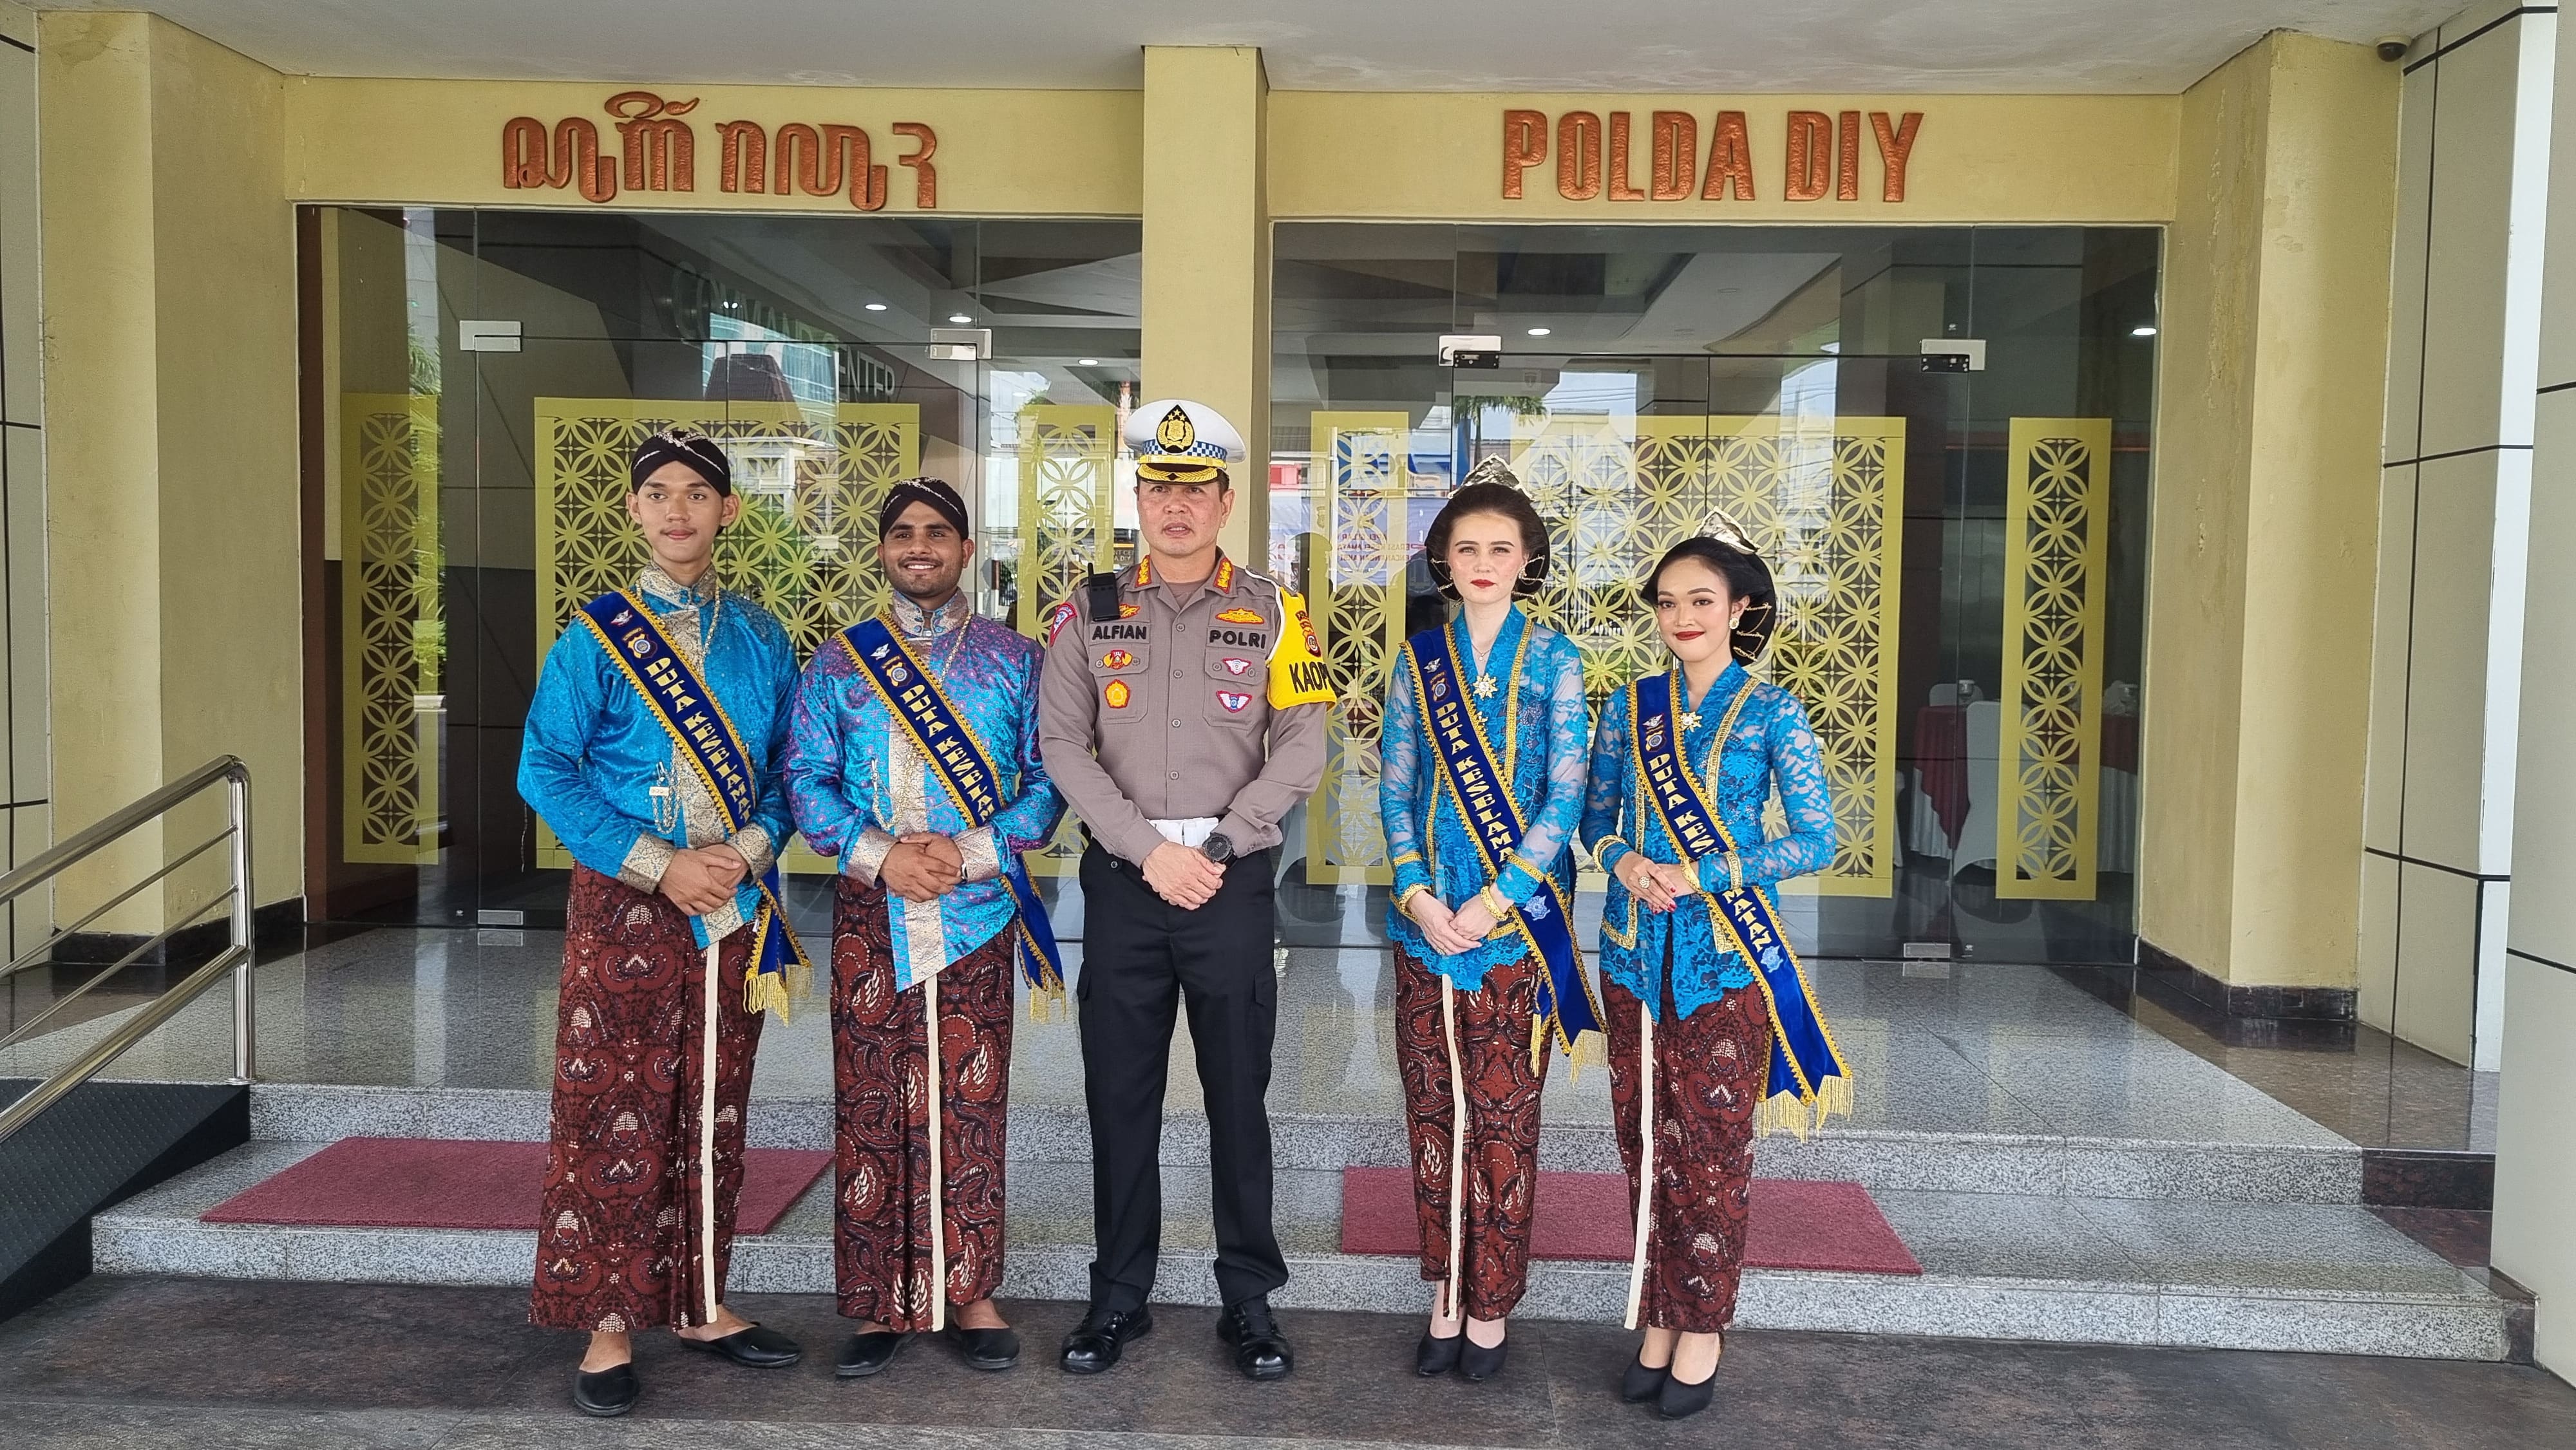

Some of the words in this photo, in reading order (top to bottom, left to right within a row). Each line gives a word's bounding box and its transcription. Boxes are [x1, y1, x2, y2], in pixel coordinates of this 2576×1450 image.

[1502, 109, 1756, 202] POLDA
[1784, 110, 1924, 202] DIY
[1092, 625, 1147, 640] ALFIAN
[1209, 630, 1266, 649] POLRI
[1289, 661, 1329, 694] KAOP
[645, 657, 697, 713] DUTA
[683, 711, 752, 824] KESELAMAT
[900, 684, 949, 738] DUTA
[934, 736, 996, 822] KESELAM
[1435, 702, 1470, 755] DUTA
[1455, 755, 1514, 863] KESELAMA
[1647, 753, 1688, 811] DUTA
